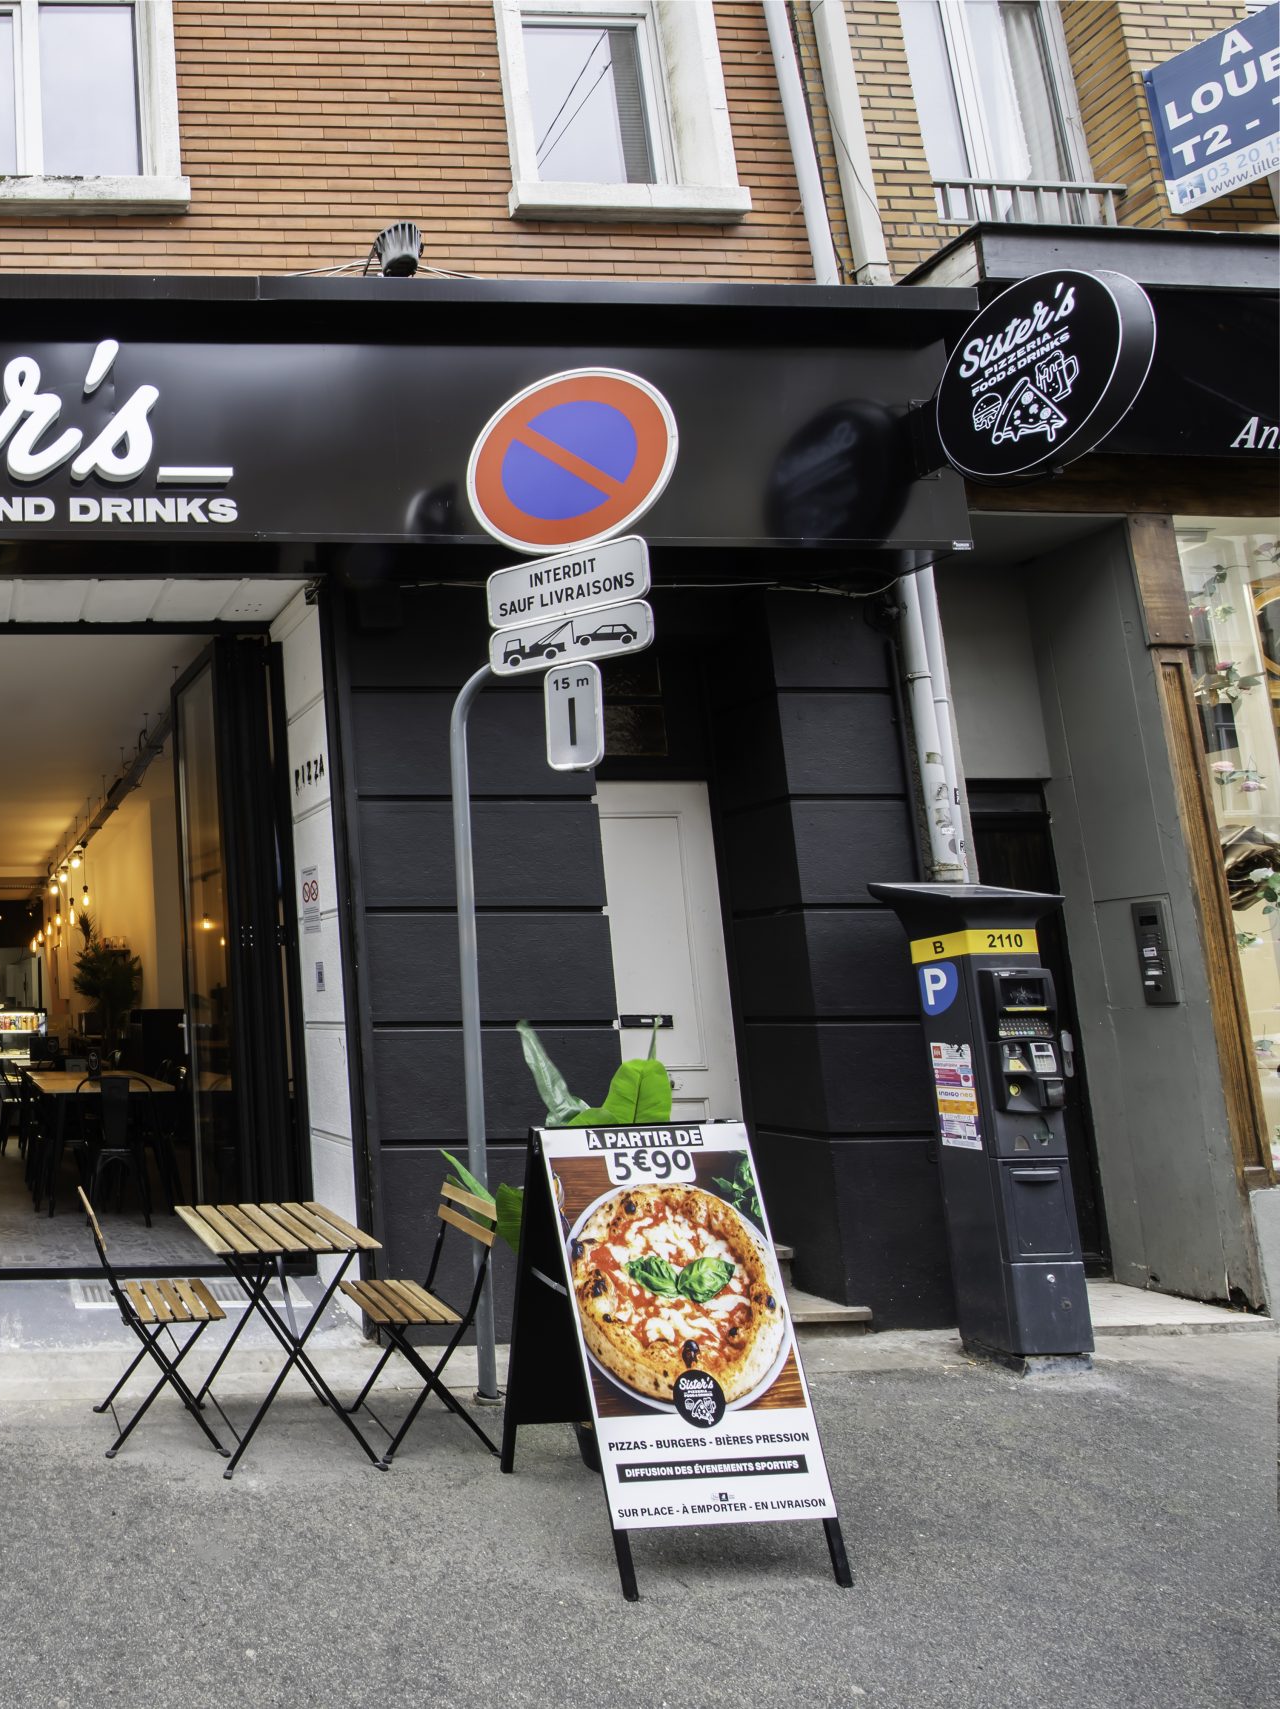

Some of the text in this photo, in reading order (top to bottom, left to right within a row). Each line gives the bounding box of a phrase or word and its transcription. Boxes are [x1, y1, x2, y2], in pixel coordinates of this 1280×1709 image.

[1220, 29, 1253, 66] A
[1172, 124, 1232, 166] T2
[1207, 137, 1279, 181] 03 20 1
[959, 282, 1076, 378] Sister's
[984, 332, 1052, 378] PIZZERIA
[1230, 416, 1279, 450] An
[69, 496, 239, 524] DRINKS
[529, 558, 596, 588] INTERDIT
[499, 572, 635, 617] SAUF LIVRAISONS
[553, 677, 589, 691] 15 m
[295, 754, 324, 792] PIZZA
[932, 940, 945, 955] B
[987, 933, 1023, 949] 2110
[588, 1129, 702, 1148] À PARTIR DE
[613, 1149, 691, 1181] 5€90
[678, 1376, 714, 1390] Sister's
[608, 1440, 647, 1451] PIZZAS
[656, 1438, 707, 1449] BURGERS
[715, 1434, 753, 1446] BIÈRES
[755, 1432, 810, 1444] PRESSION
[625, 1460, 799, 1478] DIFFUSION DES ÉVENEMENTS SPORTIFS
[618, 1508, 639, 1518] SUR
[640, 1506, 674, 1516] PLACE
[682, 1504, 689, 1514] À
[691, 1503, 747, 1514] EMPORTER
[754, 1501, 768, 1511] EN
[771, 1498, 826, 1510] LIVRAISON
